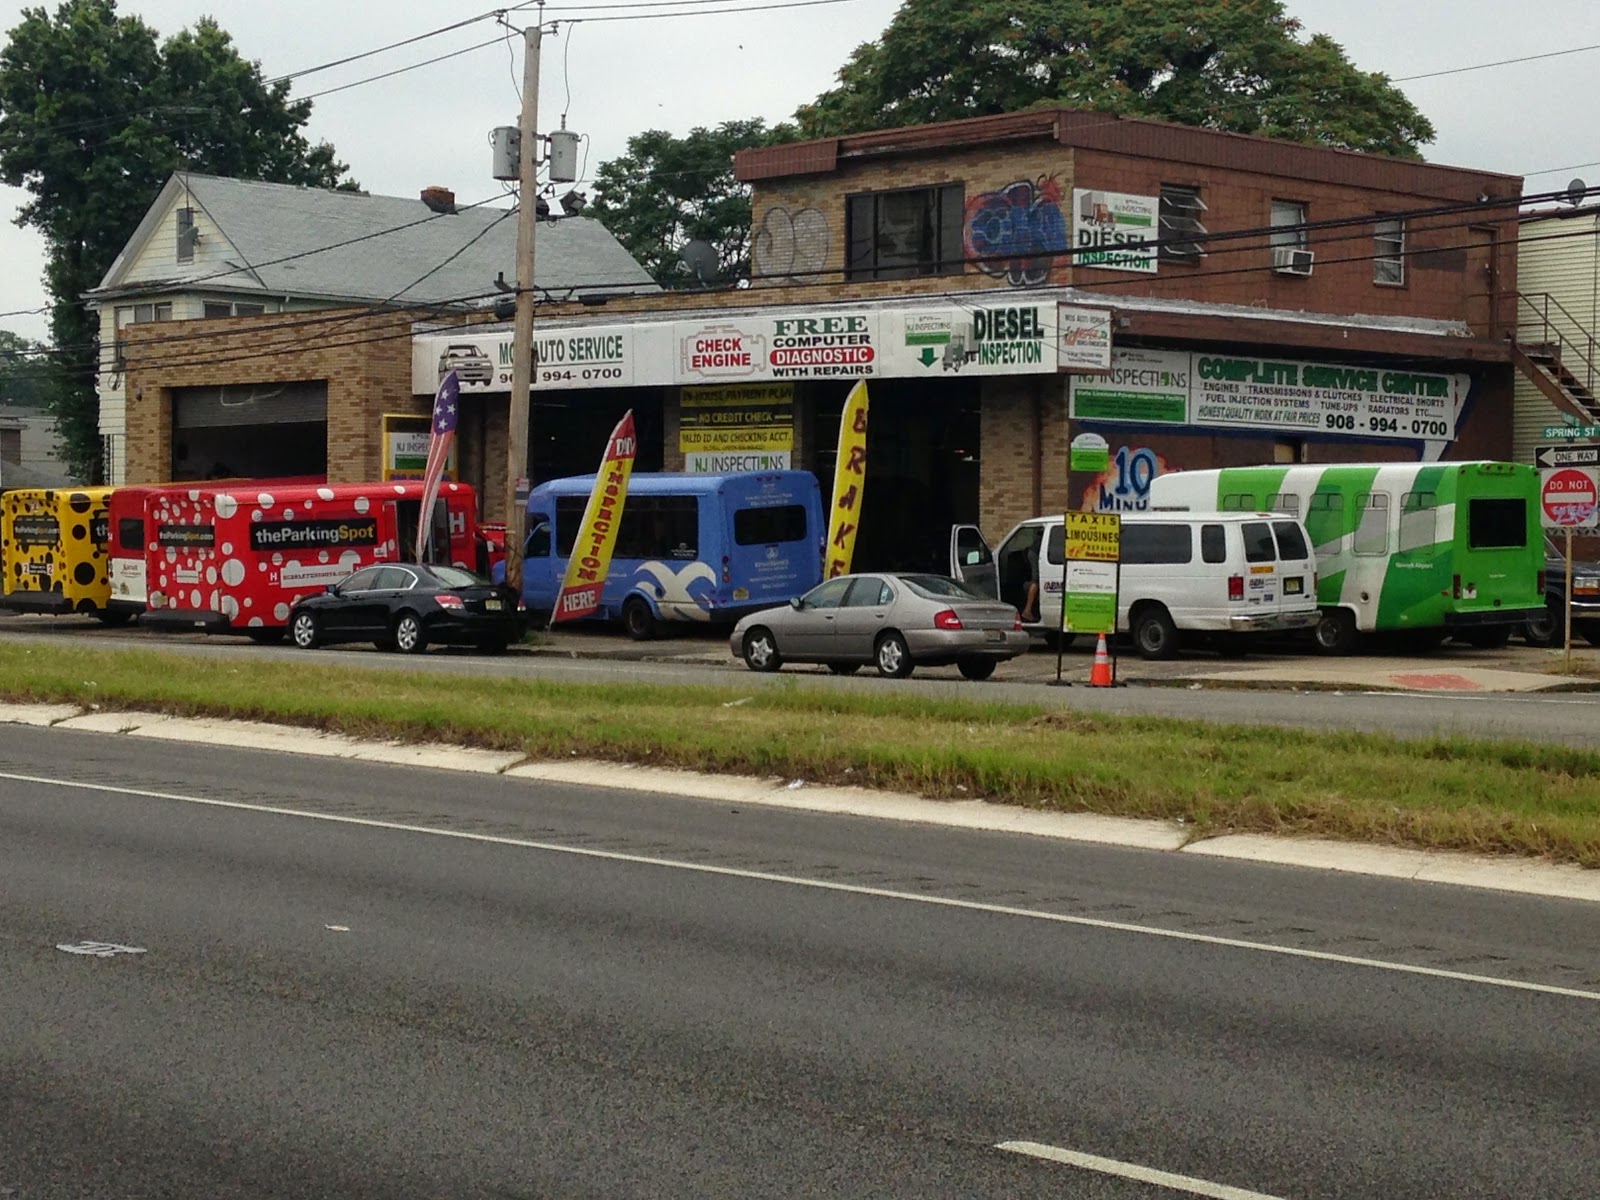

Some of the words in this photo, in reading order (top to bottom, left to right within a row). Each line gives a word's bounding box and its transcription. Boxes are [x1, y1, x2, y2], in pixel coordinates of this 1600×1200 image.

[773, 316, 868, 336] FREE
[974, 306, 1044, 341] DIESEL
[569, 335, 623, 361] SERVICE
[696, 338, 742, 352] CHECK
[773, 335, 871, 347] COMPUTER
[692, 353, 751, 367] ENGINE
[776, 348, 868, 364] DIAGNOSTIC
[978, 341, 1042, 365] INSPECTION
[582, 368, 622, 380] 0700
[773, 367, 808, 377] WITH
[813, 365, 873, 376] REPAIRS
[1199, 357, 1298, 386] COMPLETE
[1302, 365, 1378, 392] SERVICE
[1381, 372, 1449, 398] CENTER
[1203, 382, 1240, 393] ENGINES
[1248, 386, 1312, 398] TRANSMISSIONS
[1322, 391, 1362, 401] CLUTCHES
[1370, 395, 1414, 405] ELECTRICAL
[1416, 398, 1445, 407] SHORTS
[1206, 393, 1226, 403] FUEL
[1229, 395, 1271, 406] INJECTION
[1273, 399, 1310, 409] SYSTEMS
[1368, 404, 1409, 415] RADIATORS
[711, 412, 742, 423] CREDIT
[745, 411, 773, 422] CHECK
[1299, 413, 1320, 424] PRICES
[1326, 414, 1355, 430] 908
[1369, 417, 1398, 432] 994
[1411, 419, 1447, 436] 0700
[1545, 428, 1580, 438] SPRING
[1584, 427, 1595, 436] ST
[713, 434, 728, 443] AND
[730, 432, 768, 443] CHECKING
[1555, 452, 1573, 461] ONE
[1576, 451, 1595, 460] WAY
[1115, 451, 1153, 498] 10
[1549, 481, 1563, 490] DO
[1568, 480, 1588, 489] NOT
[1099, 483, 1148, 511] MINU
[1070, 514, 1117, 526] TAXIS
[255, 526, 374, 543] theParkingSpot
[1065, 529, 1119, 543] LIMOUSINES
[563, 590, 597, 613] HERE
